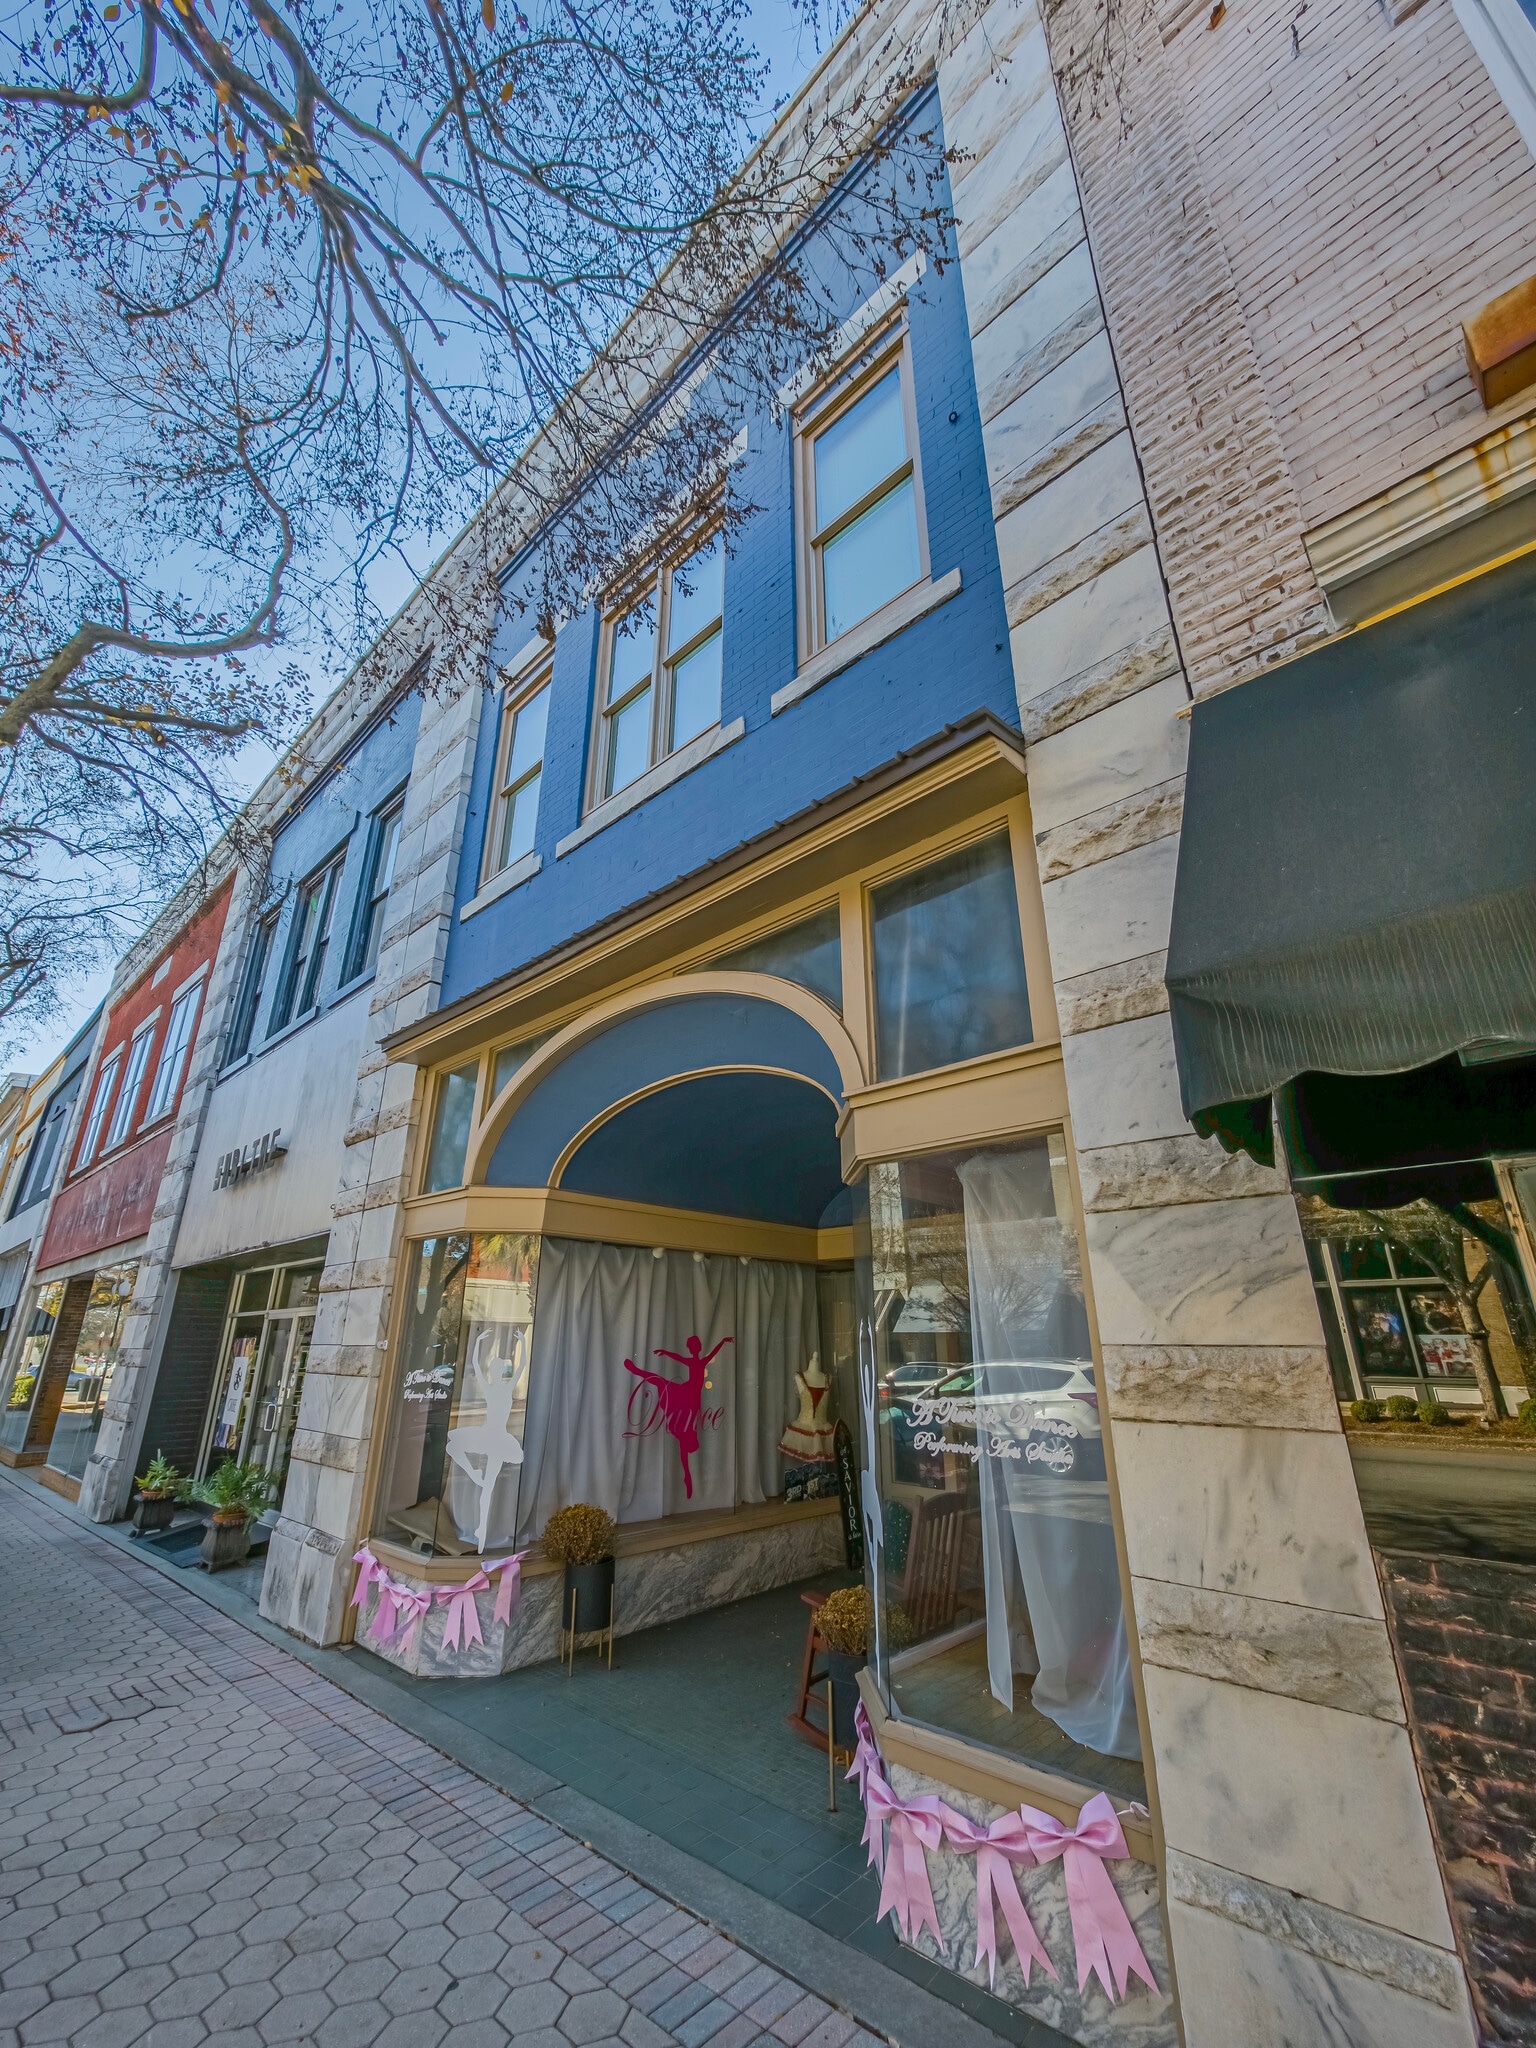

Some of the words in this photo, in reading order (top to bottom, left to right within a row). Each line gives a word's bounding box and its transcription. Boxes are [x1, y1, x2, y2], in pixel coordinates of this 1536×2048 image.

[622, 1376, 725, 1438] Dance
[906, 1397, 935, 1427] A
[935, 1396, 979, 1424] Time
[983, 1407, 1001, 1425] to
[1004, 1401, 1078, 1439] Dance
[913, 1431, 983, 1463] Performing
[986, 1436, 1021, 1460] Arts
[1025, 1442, 1074, 1465] Studio
[842, 1457, 857, 1531] SAVIOR
